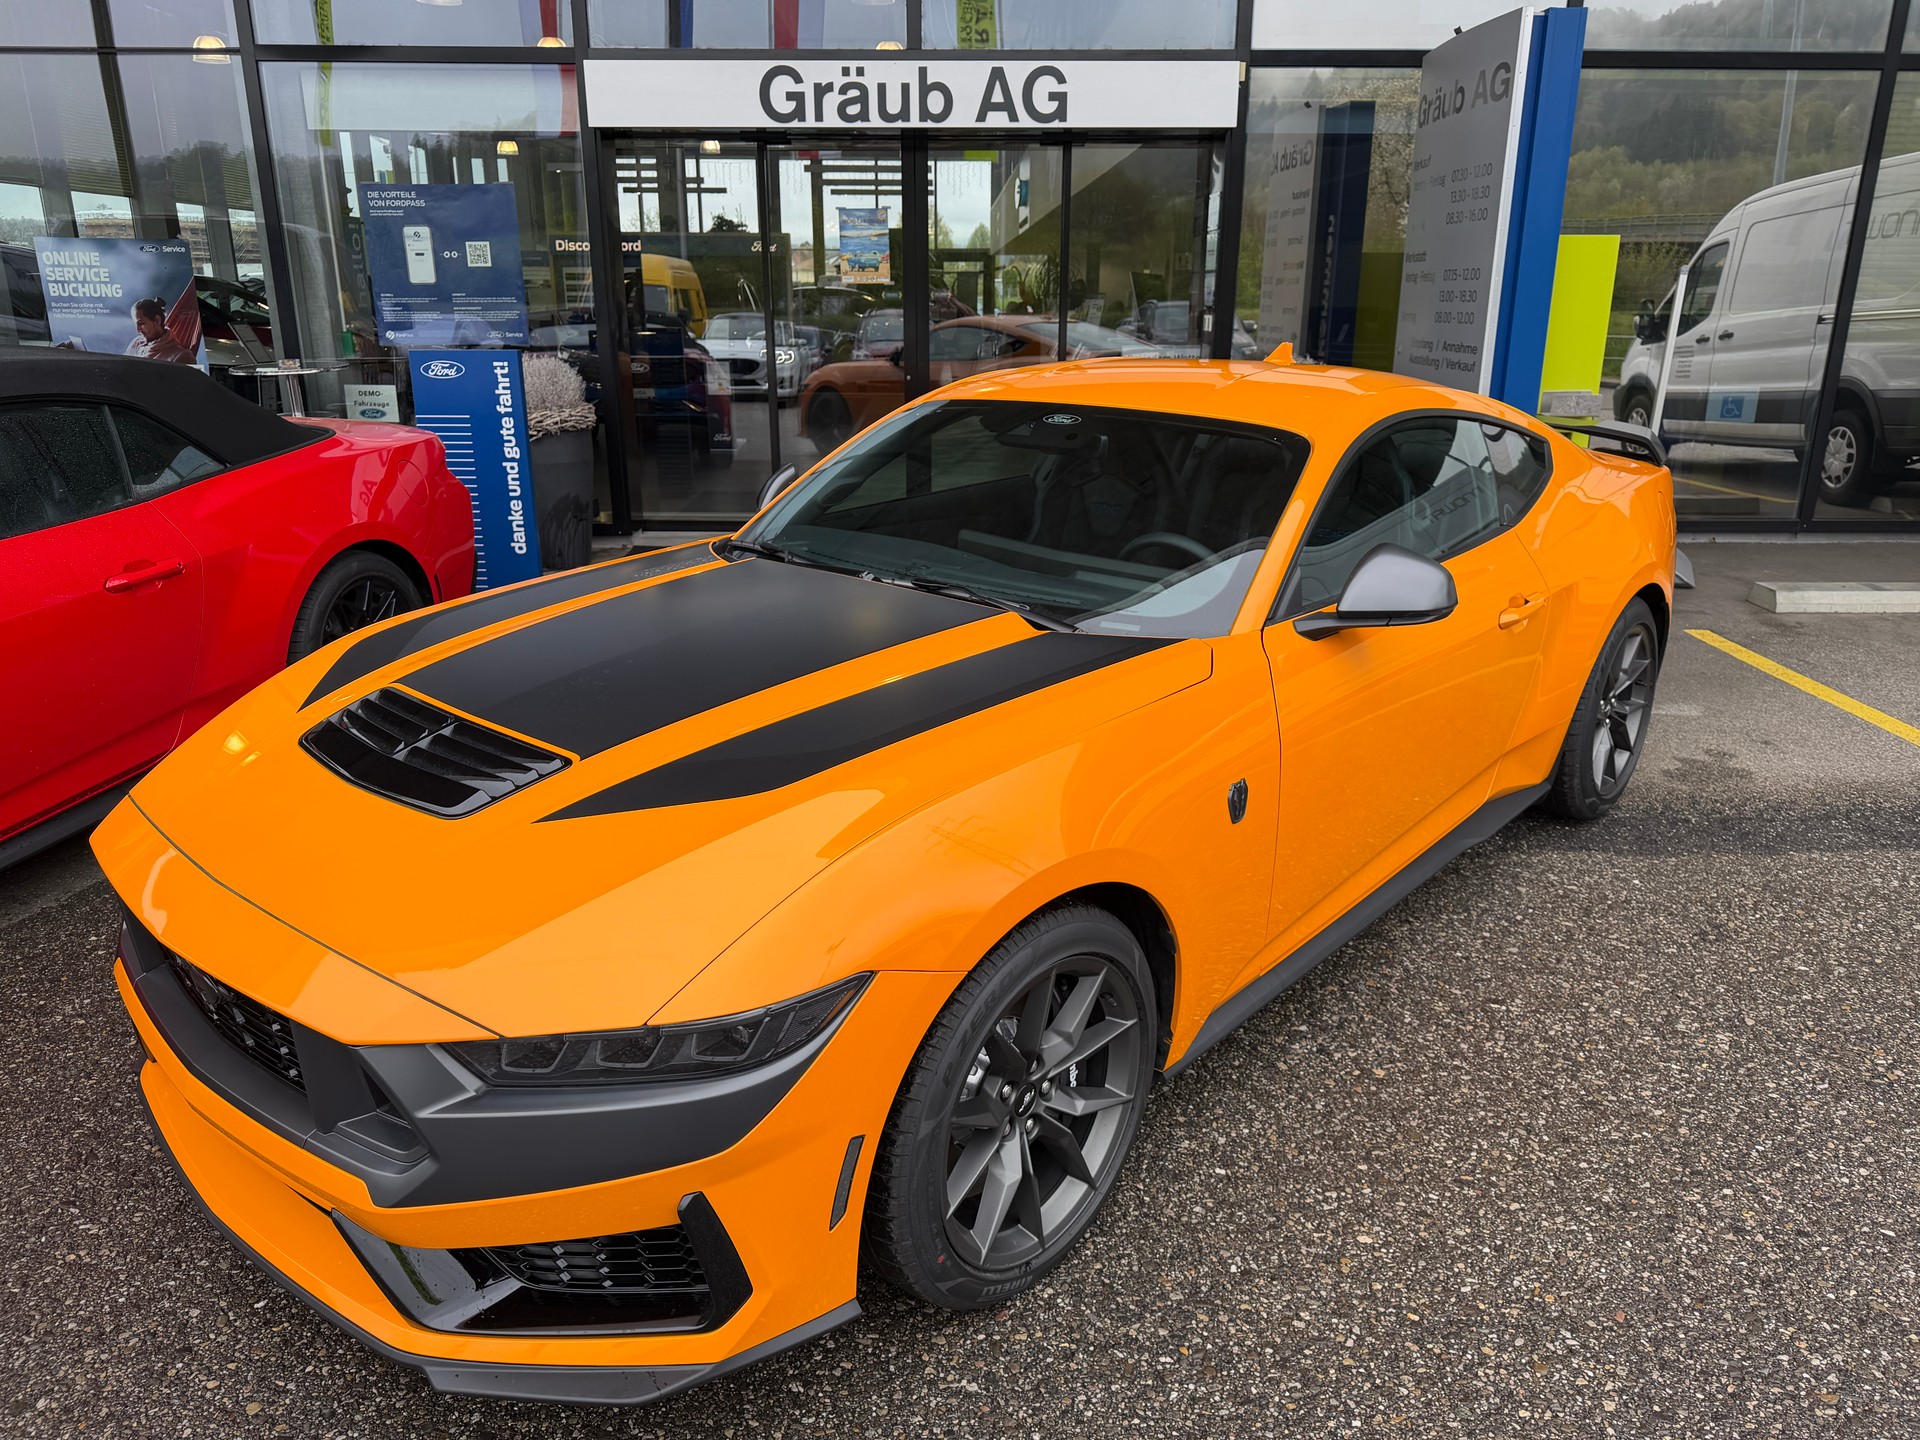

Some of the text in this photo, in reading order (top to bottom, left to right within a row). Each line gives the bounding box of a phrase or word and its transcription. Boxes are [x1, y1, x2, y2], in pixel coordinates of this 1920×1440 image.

[759, 64, 1068, 124] Gräub AG
[1418, 61, 1512, 129] Gräub AG
[1473, 162, 1493, 179] 12.00
[380, 191, 417, 199] VORTEILE
[368, 199, 426, 207] VON FORDPASS
[162, 245, 186, 253] Service
[555, 239, 642, 252] Disco ord
[41, 251, 101, 266] ONLINE
[46, 266, 110, 282] SERVICE
[1462, 267, 1481, 281] 12.00
[47, 282, 123, 298] BUCHUNG
[1442, 340, 1478, 355] Annahme
[424, 362, 461, 377] Ford
[1446, 357, 1477, 373] Verkauf
[358, 390, 384, 398] DEMO-
[353, 400, 391, 408] Fahrzeuge
[362, 408, 384, 418] Ford
[492, 360, 527, 555] danke und gute fahrt!
